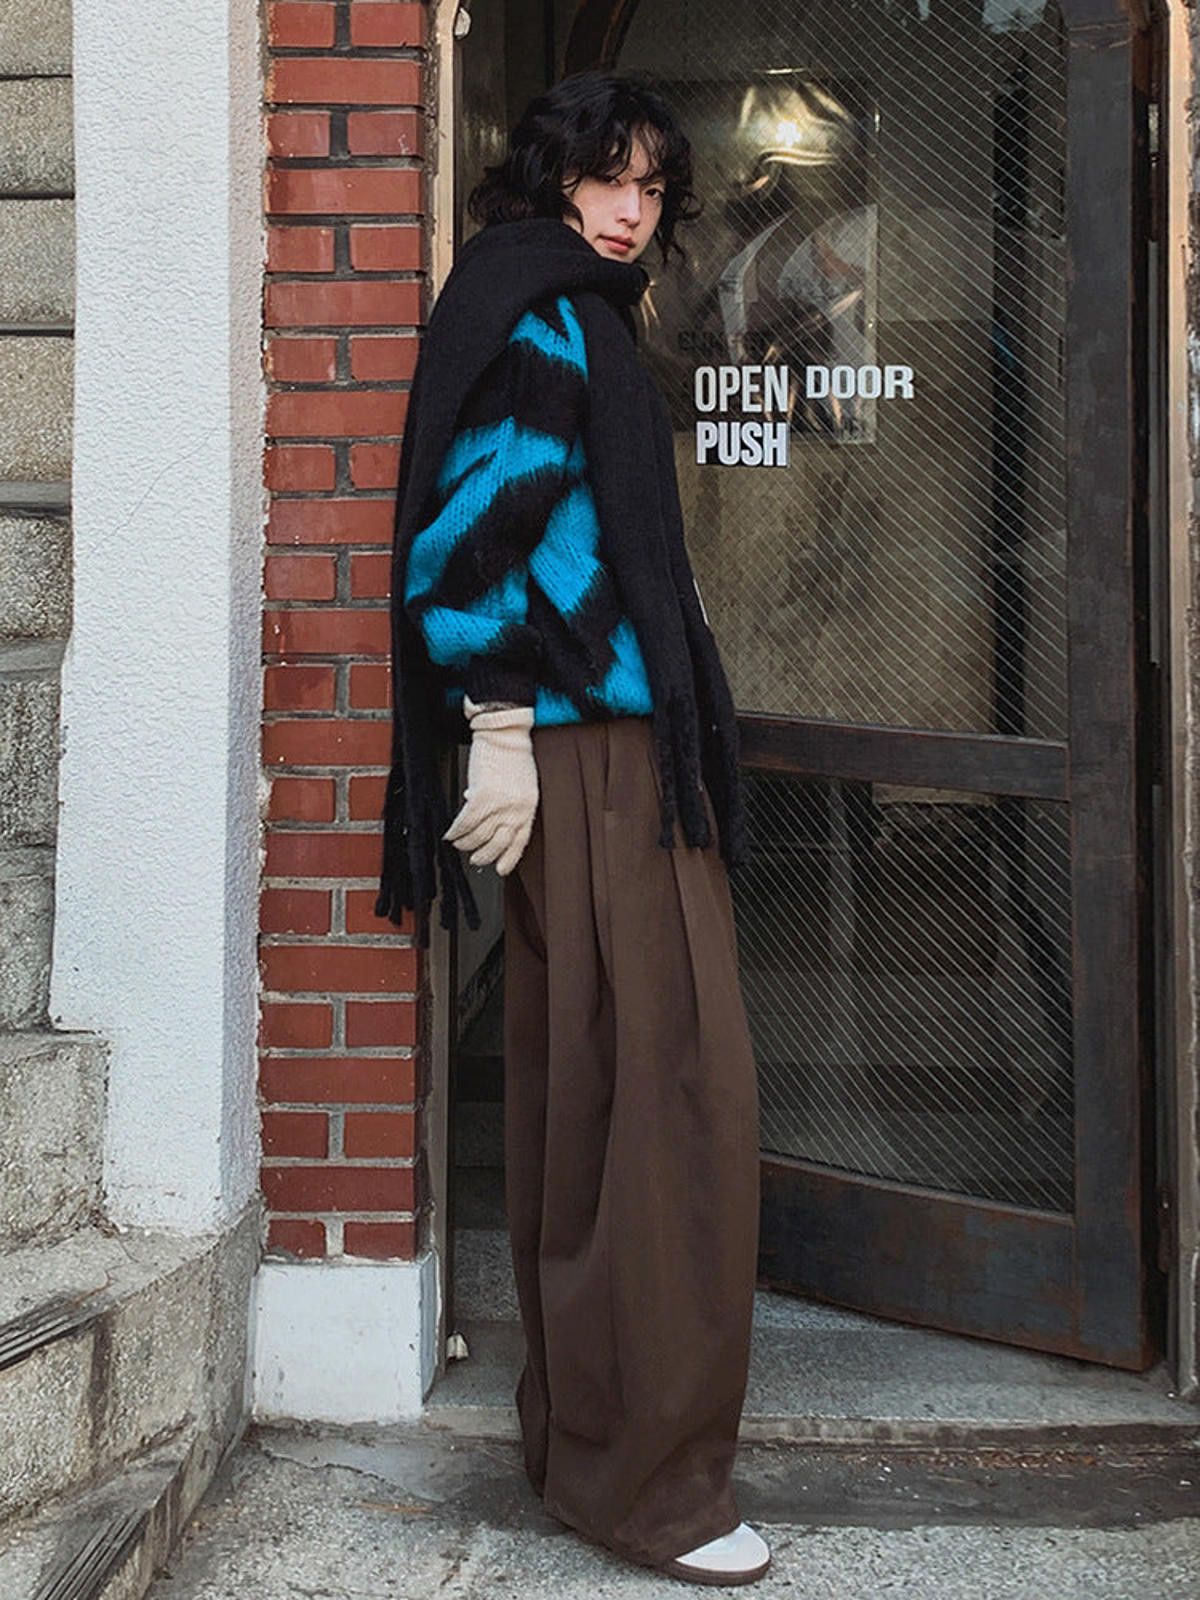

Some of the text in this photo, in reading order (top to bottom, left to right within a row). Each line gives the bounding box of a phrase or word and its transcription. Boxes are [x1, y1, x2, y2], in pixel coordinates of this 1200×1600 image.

[695, 365, 914, 412] OPEN DOOR
[696, 421, 788, 466] PUSH
